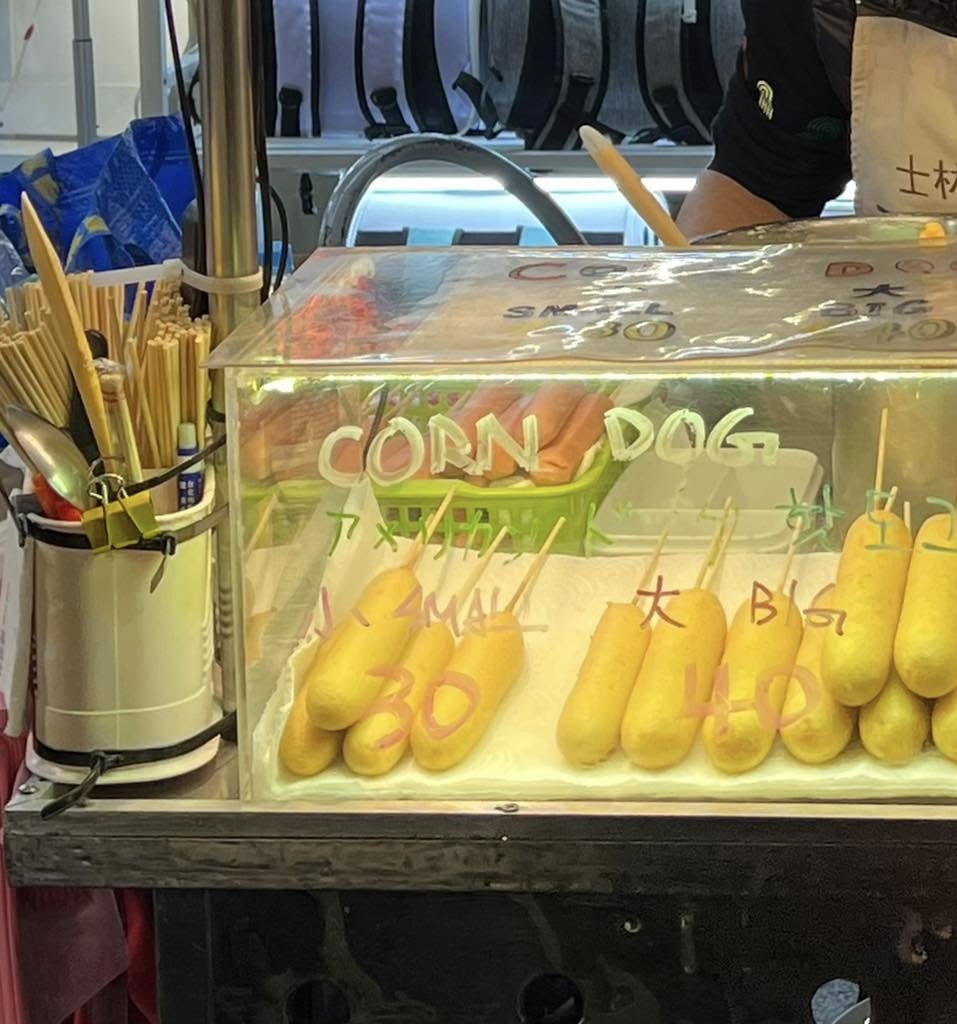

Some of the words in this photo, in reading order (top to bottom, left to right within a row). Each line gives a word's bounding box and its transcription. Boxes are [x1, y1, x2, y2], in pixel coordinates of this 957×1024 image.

[503, 302, 675, 319] SMLL
[317, 412, 544, 487] CORN
[604, 407, 780, 466] DOG
[636, 575, 687, 629] 大
[750, 579, 848, 636] BIG
[368, 663, 481, 751] 30
[684, 663, 823, 740] 40
